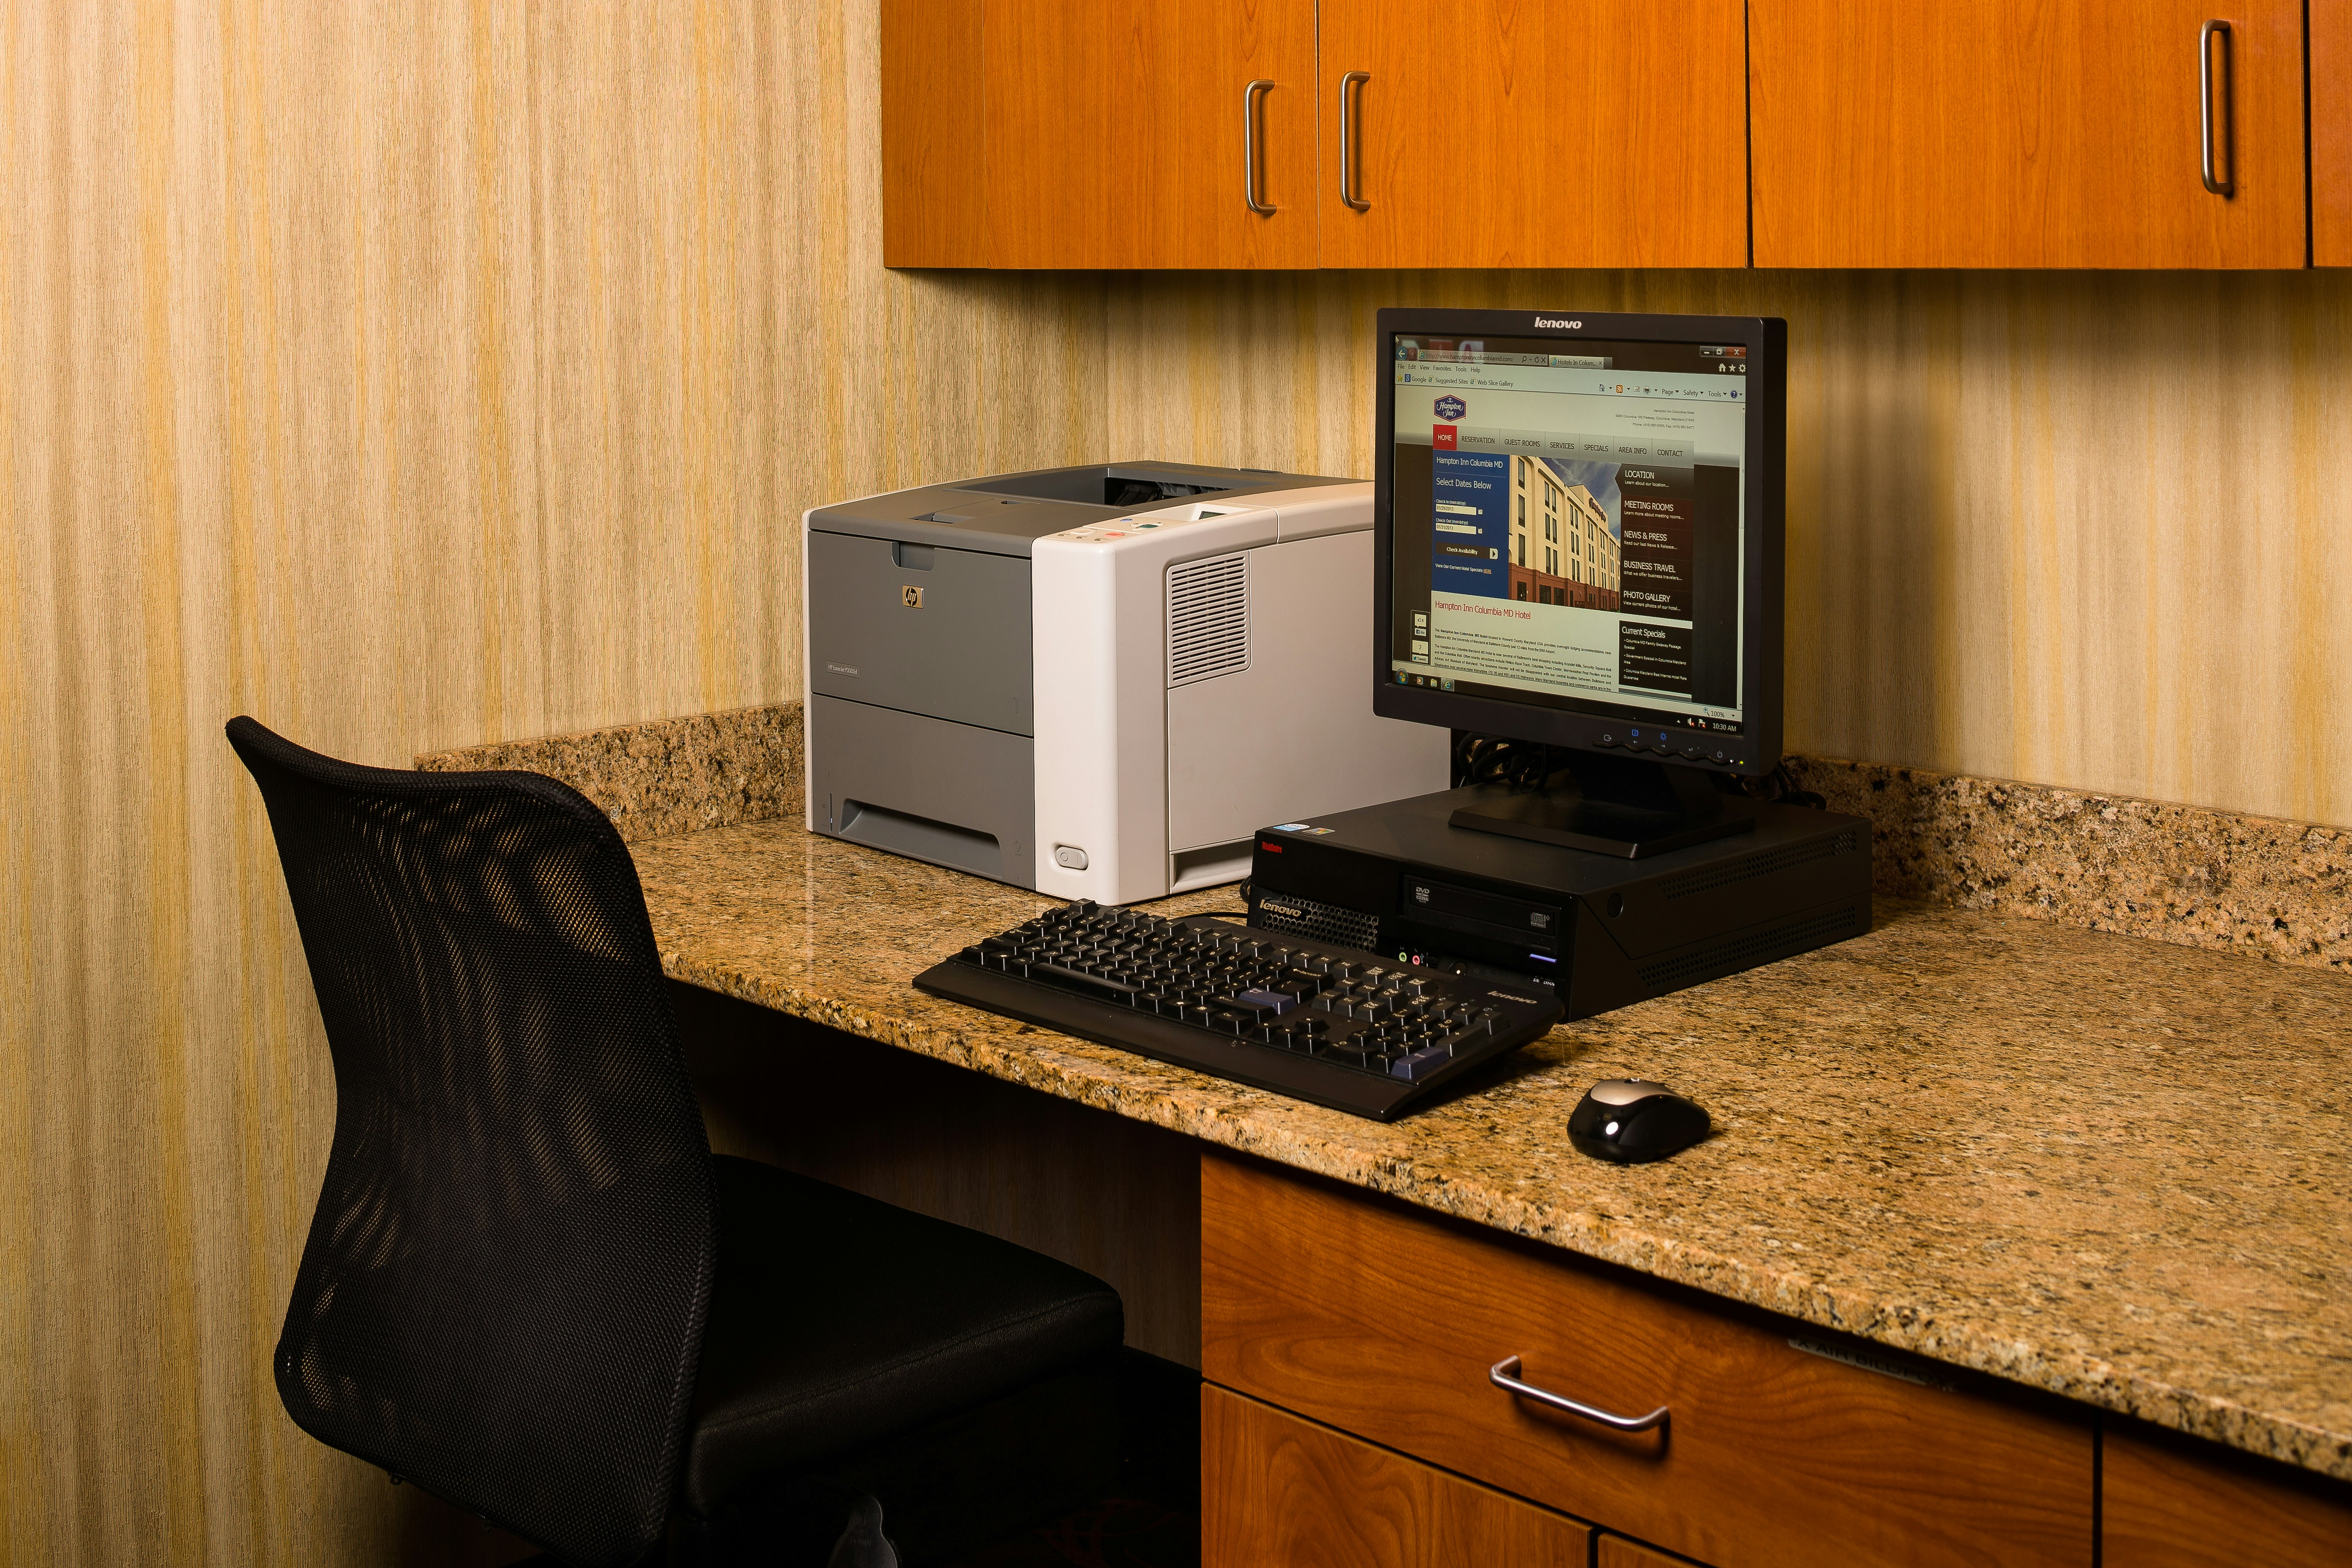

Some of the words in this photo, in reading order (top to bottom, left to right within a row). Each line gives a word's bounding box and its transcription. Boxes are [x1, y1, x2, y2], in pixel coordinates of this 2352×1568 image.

[1535, 317, 1582, 328] lenovo
[1437, 401, 1463, 412] Hampton
[1443, 409, 1456, 417] Inn
[1461, 436, 1496, 444] RESERVATION
[1437, 457, 1459, 465] Hampton
[1470, 459, 1493, 467] Columbia
[1625, 470, 1654, 479] LOCATION
[1436, 478, 1454, 486] Select
[1455, 479, 1472, 487] Dates
[1474, 481, 1491, 489] Below
[1625, 501, 1651, 509] MEETING
[1652, 503, 1674, 511] ROOMS
[1649, 533, 1667, 541] PRESS
[1624, 561, 1653, 570] BUSINESS
[1653, 564, 1676, 572] TRAVEL
[907, 587, 917, 607] hp
[1623, 591, 1644, 599] PHOTO
[1645, 593, 1670, 602] GALLERY
[1435, 601, 1461, 611] Hampton
[1463, 604, 1473, 612] Inn
[1475, 606, 1502, 616] Columbia
[1504, 609, 1514, 617] MD
[1515, 610, 1531, 619] Hotel
[1622, 626, 1643, 635] Current
[1644, 629, 1666, 638] Specials
[1711, 710, 1725, 718] 100%
[1262, 842, 1282, 853] ThinkCentre
[1260, 899, 1301, 917] lenovo
[1487, 991, 1538, 1004] lenovo
